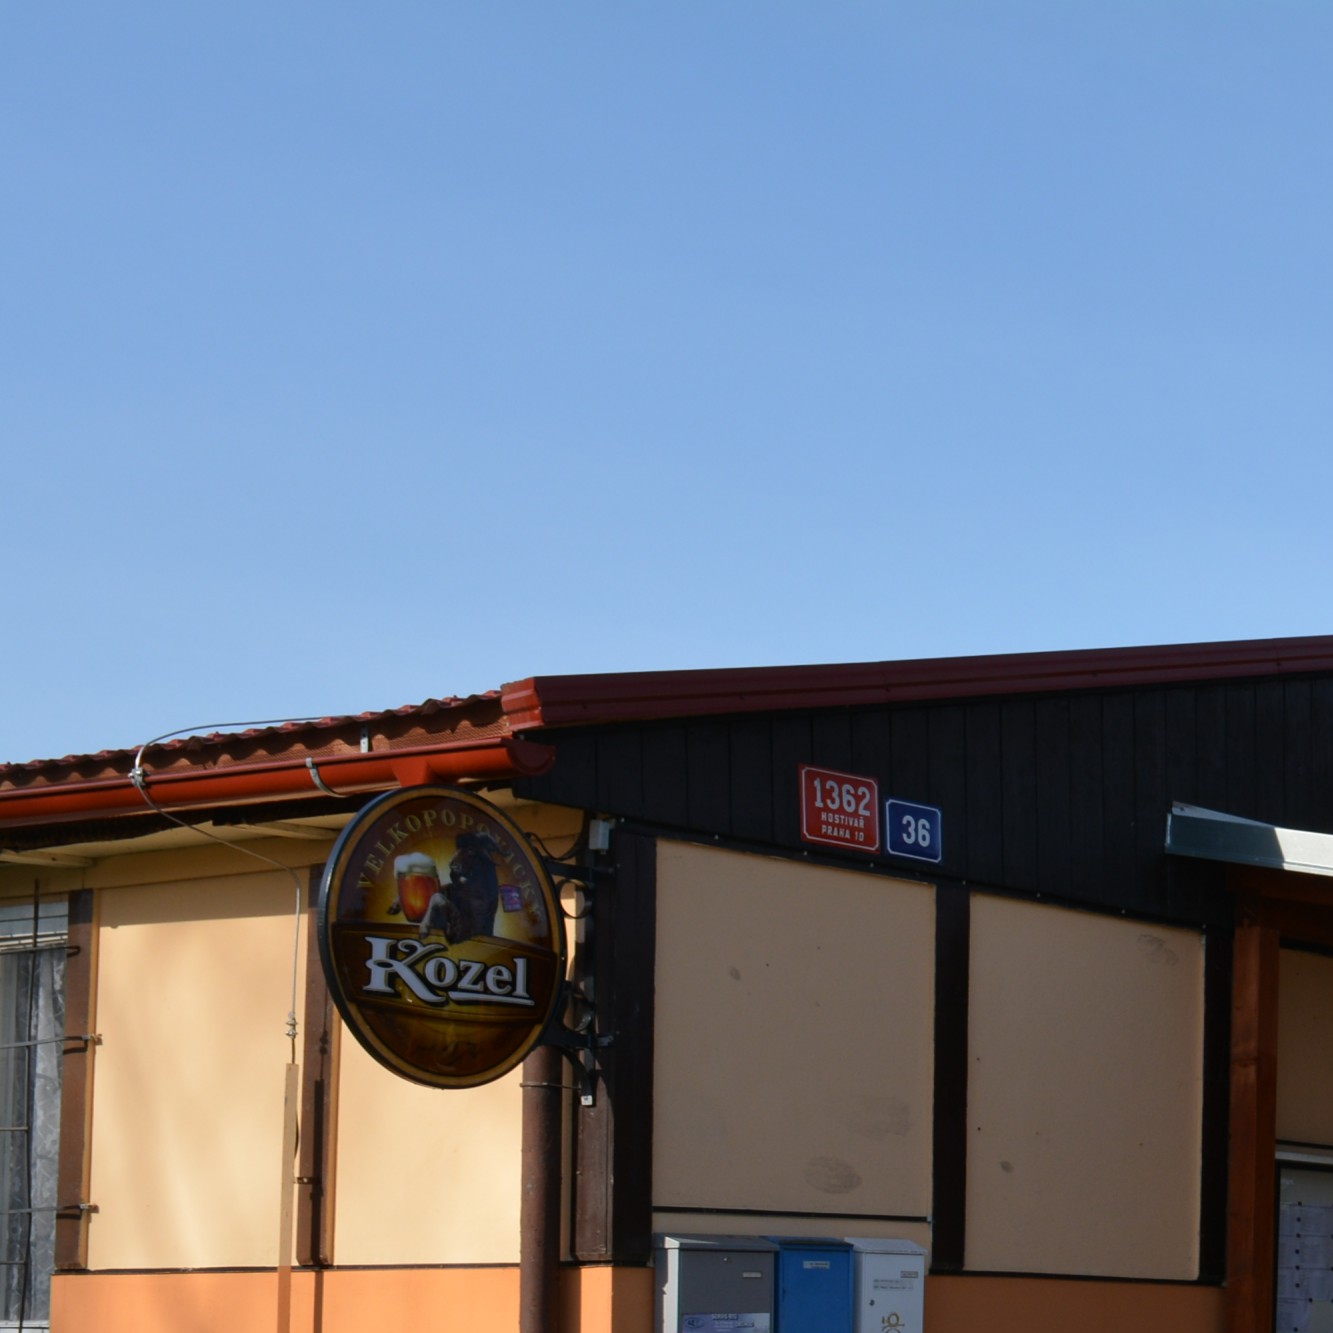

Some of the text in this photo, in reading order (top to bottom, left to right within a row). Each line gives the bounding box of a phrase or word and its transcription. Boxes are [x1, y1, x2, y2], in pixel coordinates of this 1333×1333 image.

[814, 777, 871, 817] 1362
[821, 812, 865, 829] HOSTIVAŘ
[821, 825, 865, 842] PRAHA 10
[902, 814, 931, 848] 36
[363, 936, 534, 1005] Kozel
